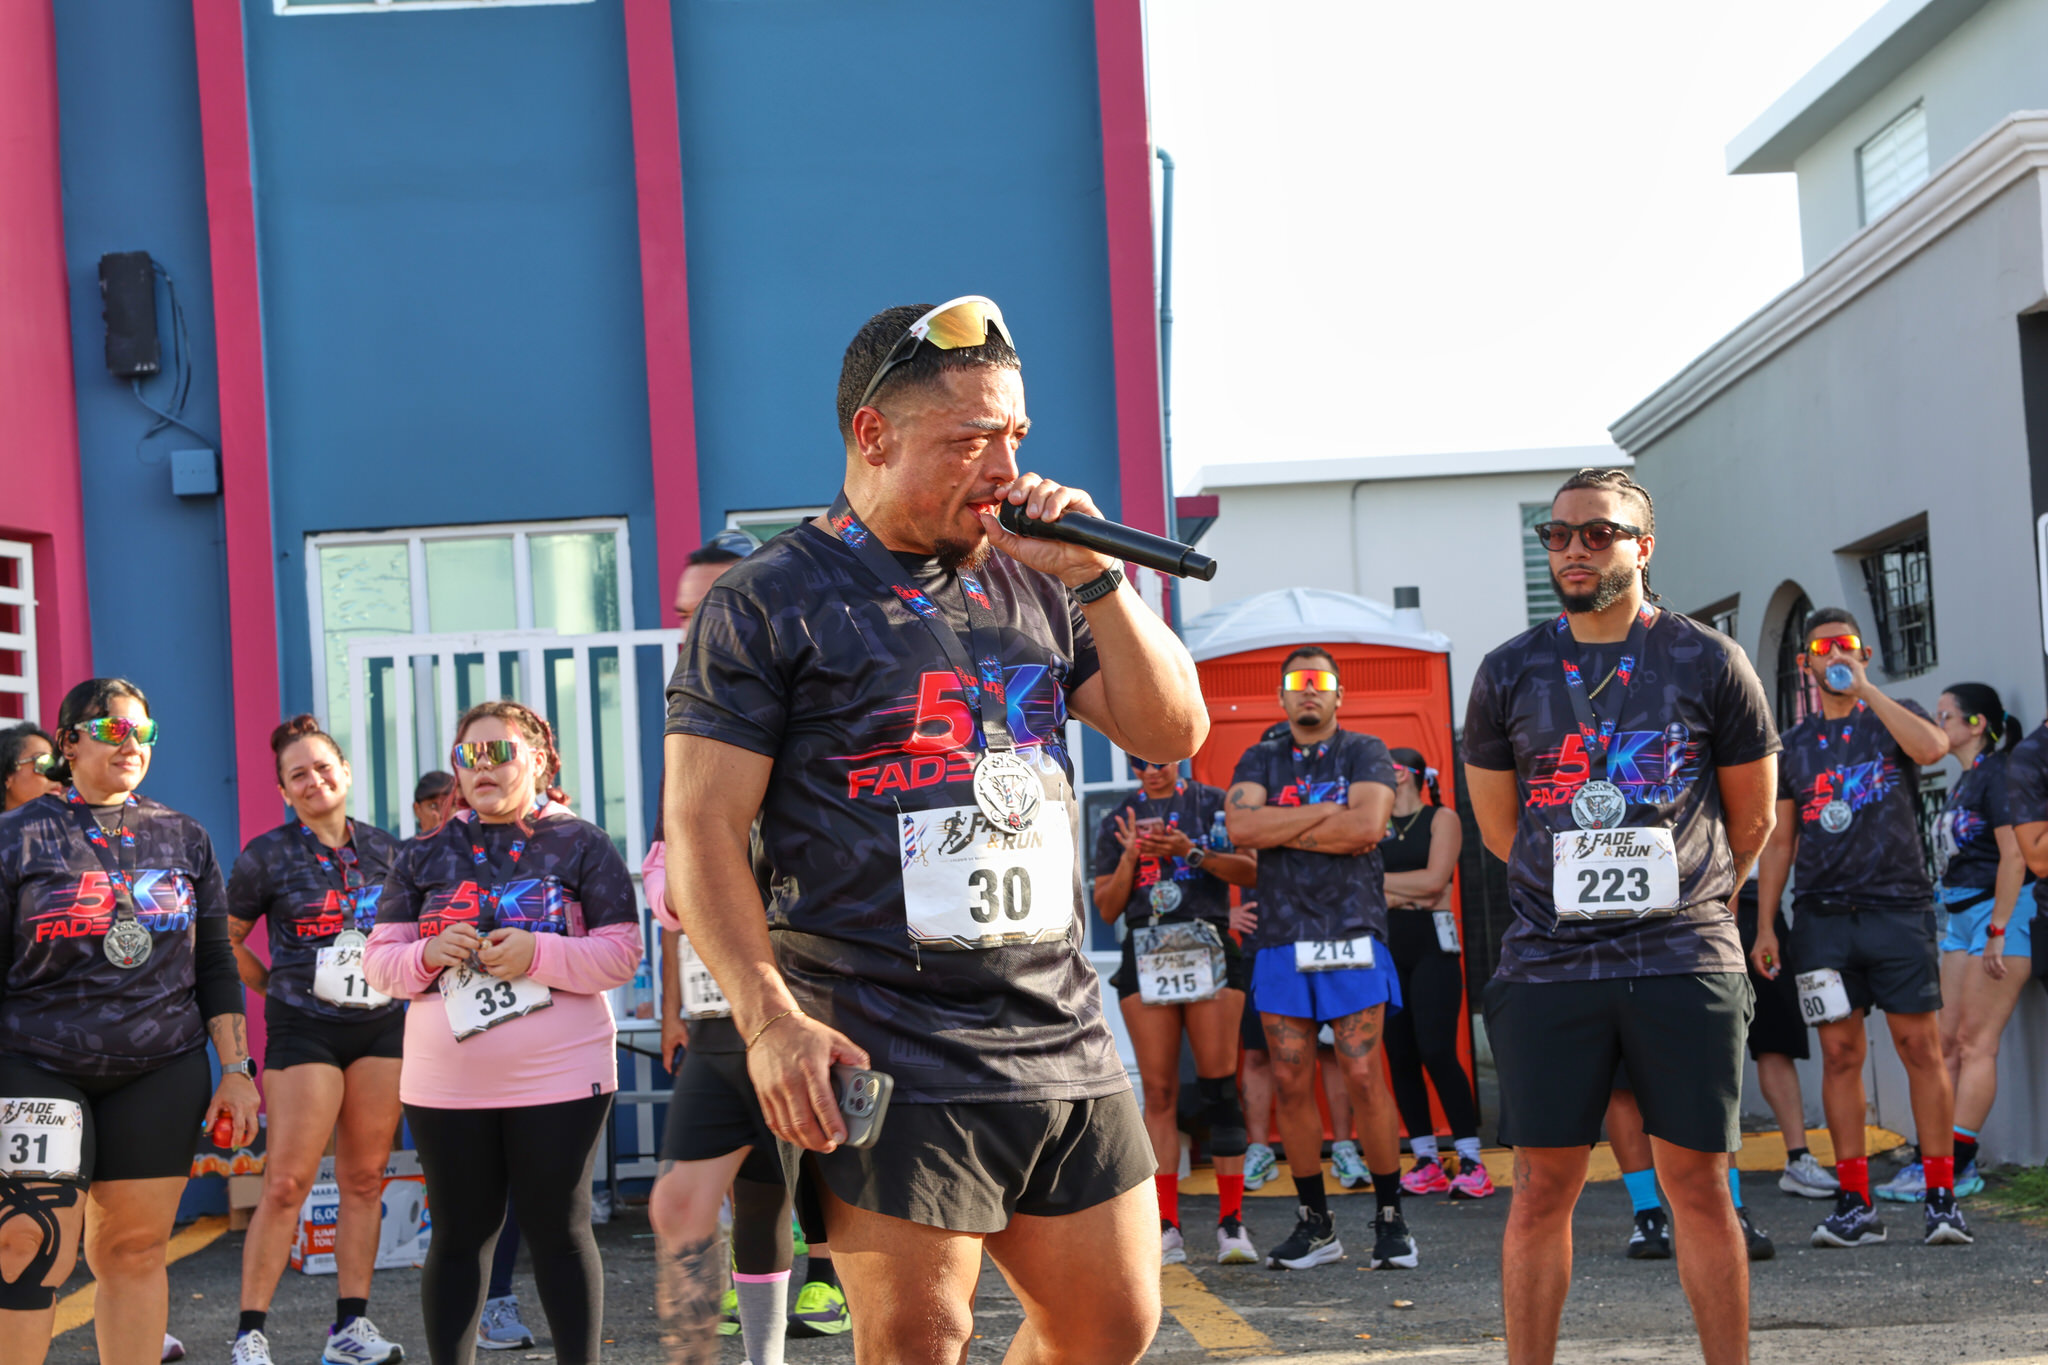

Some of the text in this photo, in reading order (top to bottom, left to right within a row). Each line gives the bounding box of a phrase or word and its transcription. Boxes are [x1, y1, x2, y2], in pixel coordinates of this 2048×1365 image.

[1552, 731, 1664, 786] 5K
[848, 752, 976, 799] FADE
[987, 831, 1043, 850] & RUN
[1593, 831, 1635, 847] FADE
[1603, 845, 1651, 858] & RUN
[968, 866, 1032, 923] 30
[1577, 867, 1650, 903] 223
[438, 879, 542, 920] 5K
[36, 916, 113, 943] FADE
[1313, 940, 1356, 961] 214
[1156, 973, 1197, 996] 215
[475, 981, 517, 1017] 33
[1803, 996, 1825, 1018] 80
[18, 1102, 56, 1115] FADE
[35, 1114, 66, 1126] RUN
[9, 1133, 48, 1165] 31
